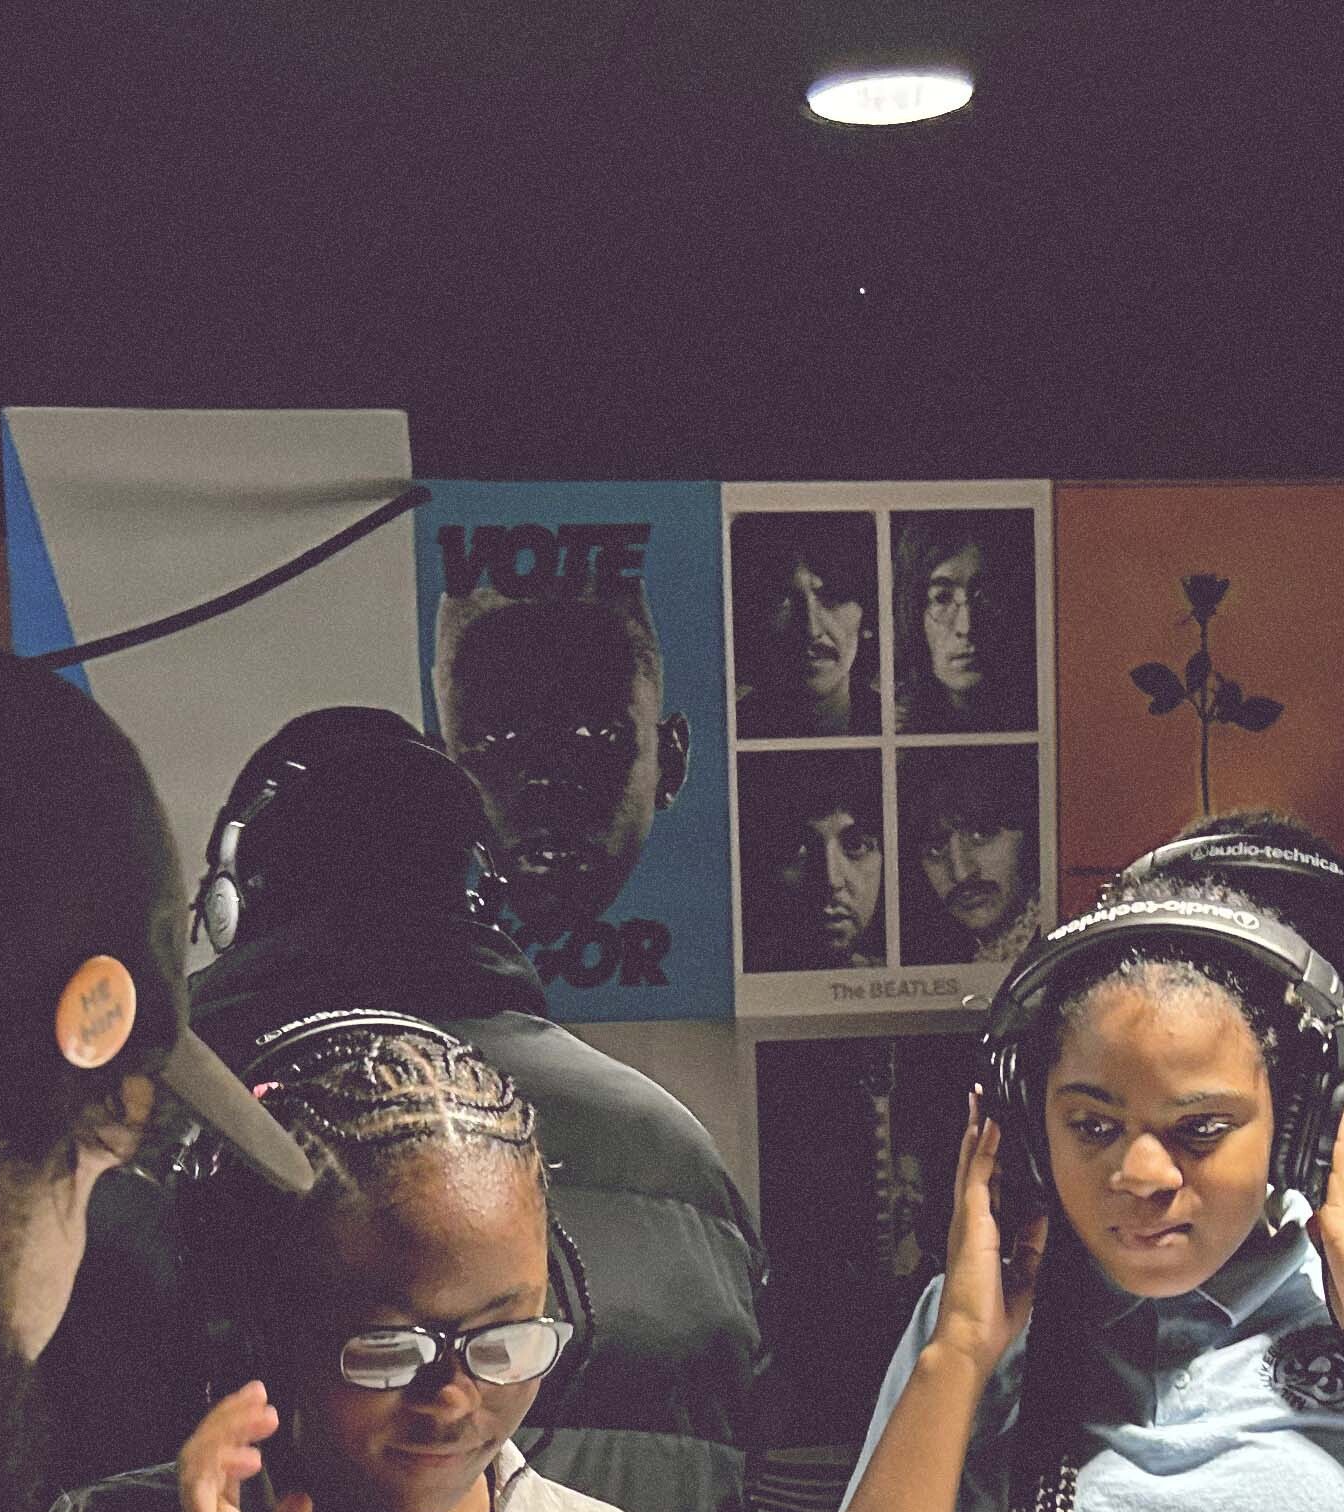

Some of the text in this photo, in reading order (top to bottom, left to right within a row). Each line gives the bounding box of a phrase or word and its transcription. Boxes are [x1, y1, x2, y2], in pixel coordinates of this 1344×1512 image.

[437, 523, 652, 599] VOTE
[831, 979, 959, 1000] The BEATLES
